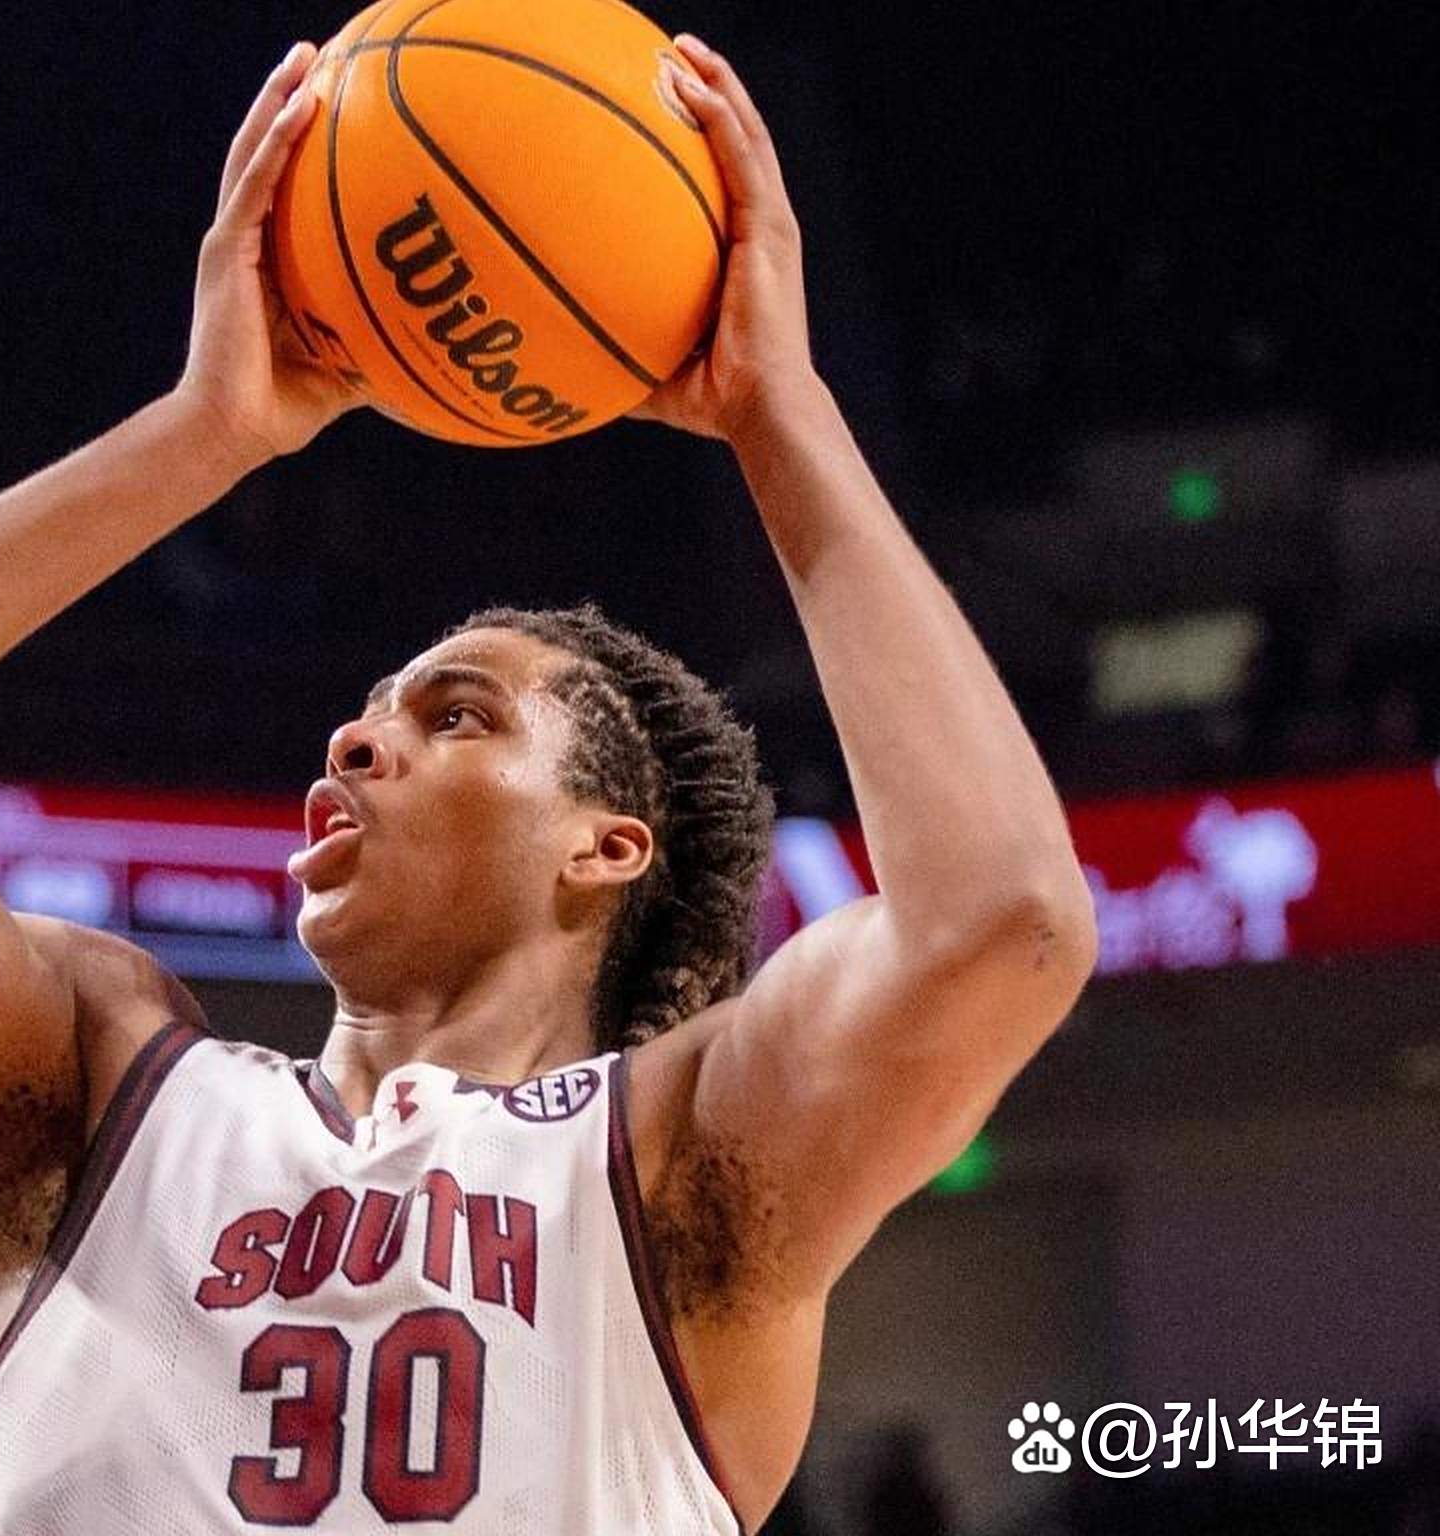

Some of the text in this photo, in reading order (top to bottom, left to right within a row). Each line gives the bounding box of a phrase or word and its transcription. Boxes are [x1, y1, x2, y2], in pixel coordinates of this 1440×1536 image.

[374, 192, 589, 433] Wilson
[509, 1070, 595, 1119] SEC
[194, 1168, 538, 1329] SOUTH
[227, 1307, 487, 1527] 30
